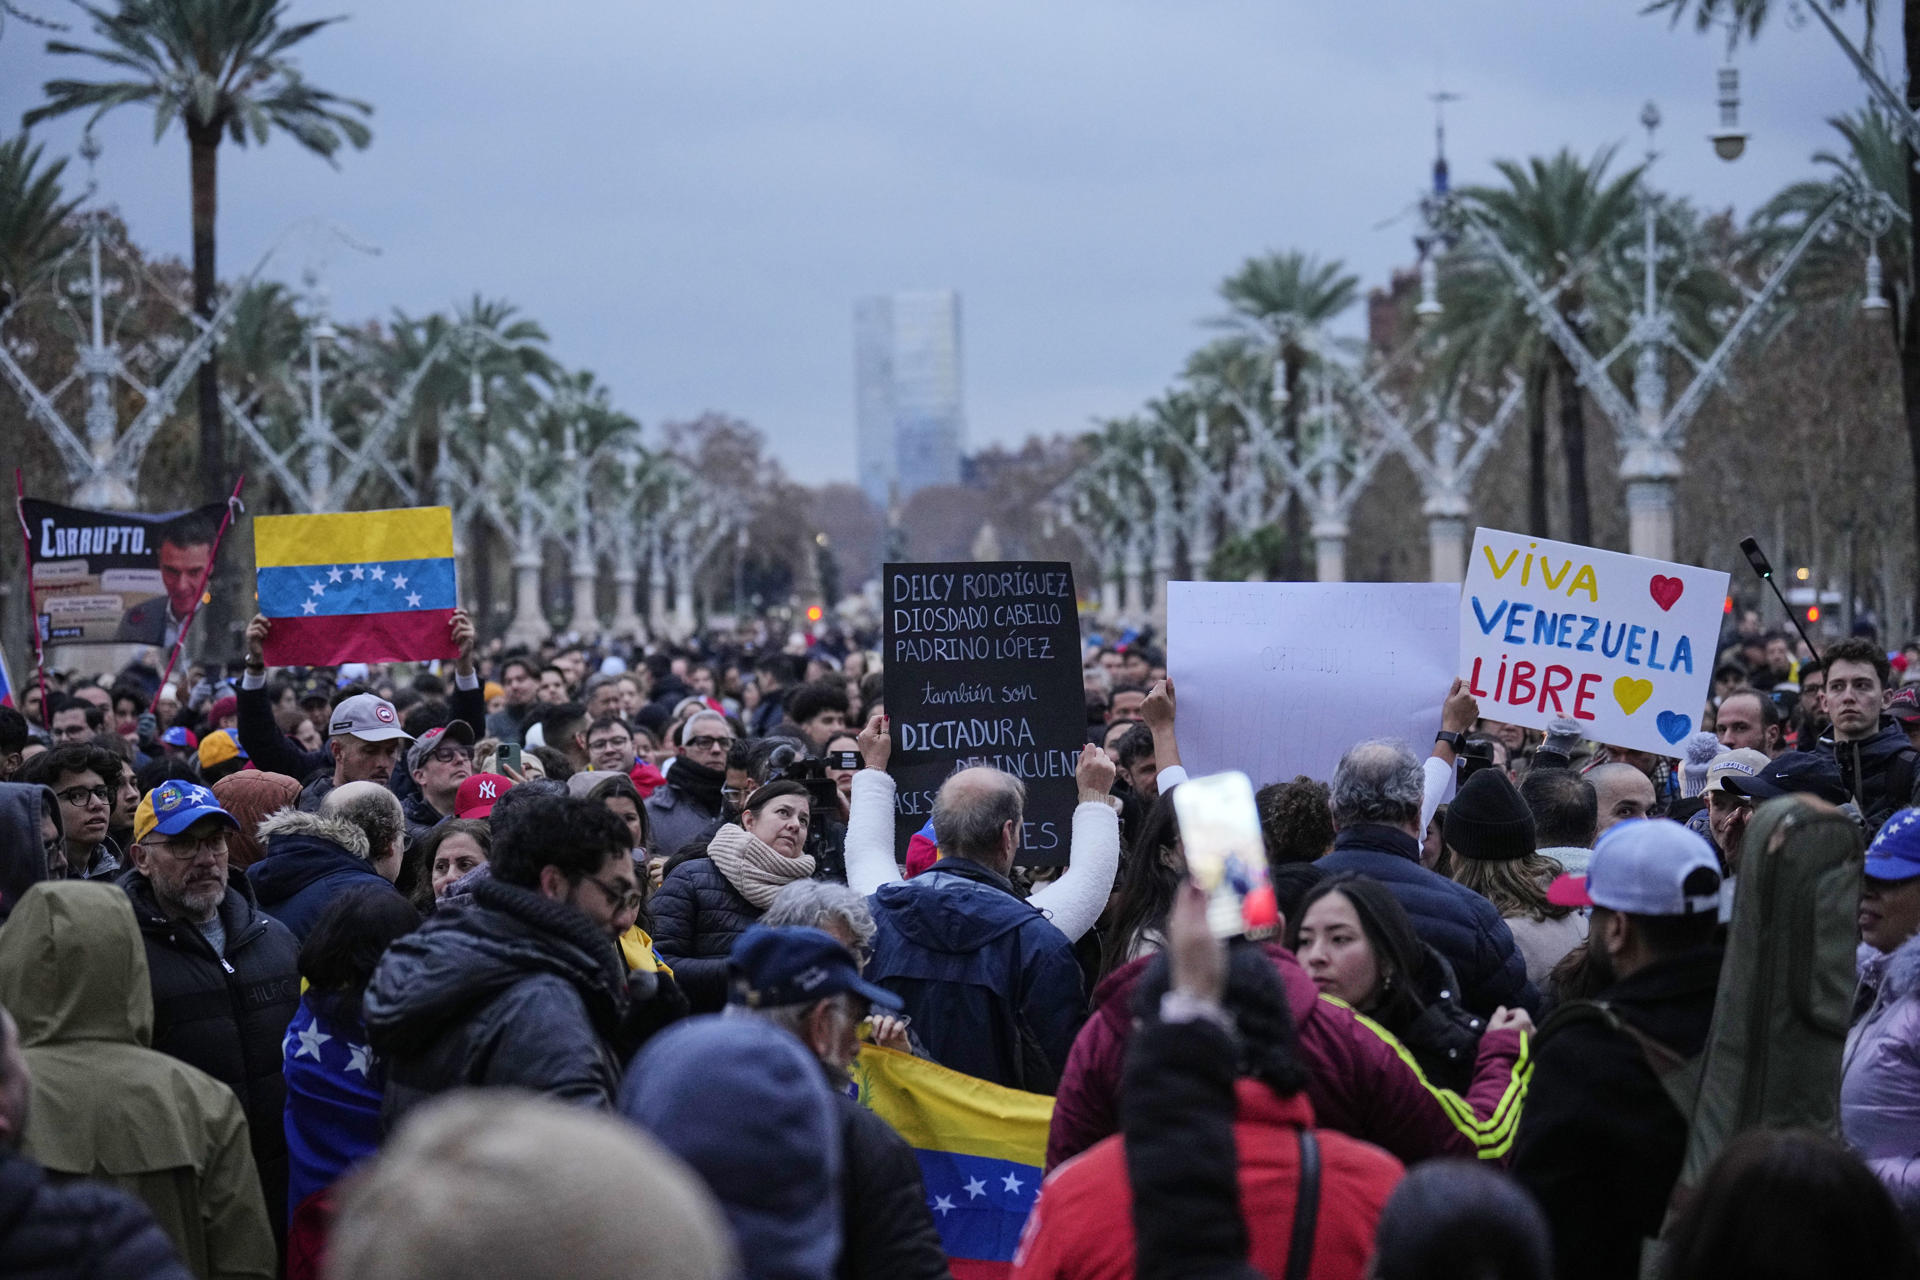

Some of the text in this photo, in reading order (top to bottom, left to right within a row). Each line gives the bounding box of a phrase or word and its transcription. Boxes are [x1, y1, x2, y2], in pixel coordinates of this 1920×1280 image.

[893, 565, 1069, 602] DELCY RODRÍGUEZ
[1483, 543, 1598, 602] VIVA
[894, 603, 1061, 634] DIOSDADO CABELLO
[896, 629, 1055, 662] PADRINO LÓPEZ
[1471, 596, 1693, 675] VENEZUELA
[921, 680, 1038, 704] también son
[1469, 654, 1603, 720] LIBRE
[902, 717, 1036, 750] DICTADURA
[478, 780, 497, 799] NY
[894, 790, 939, 815] ASES
